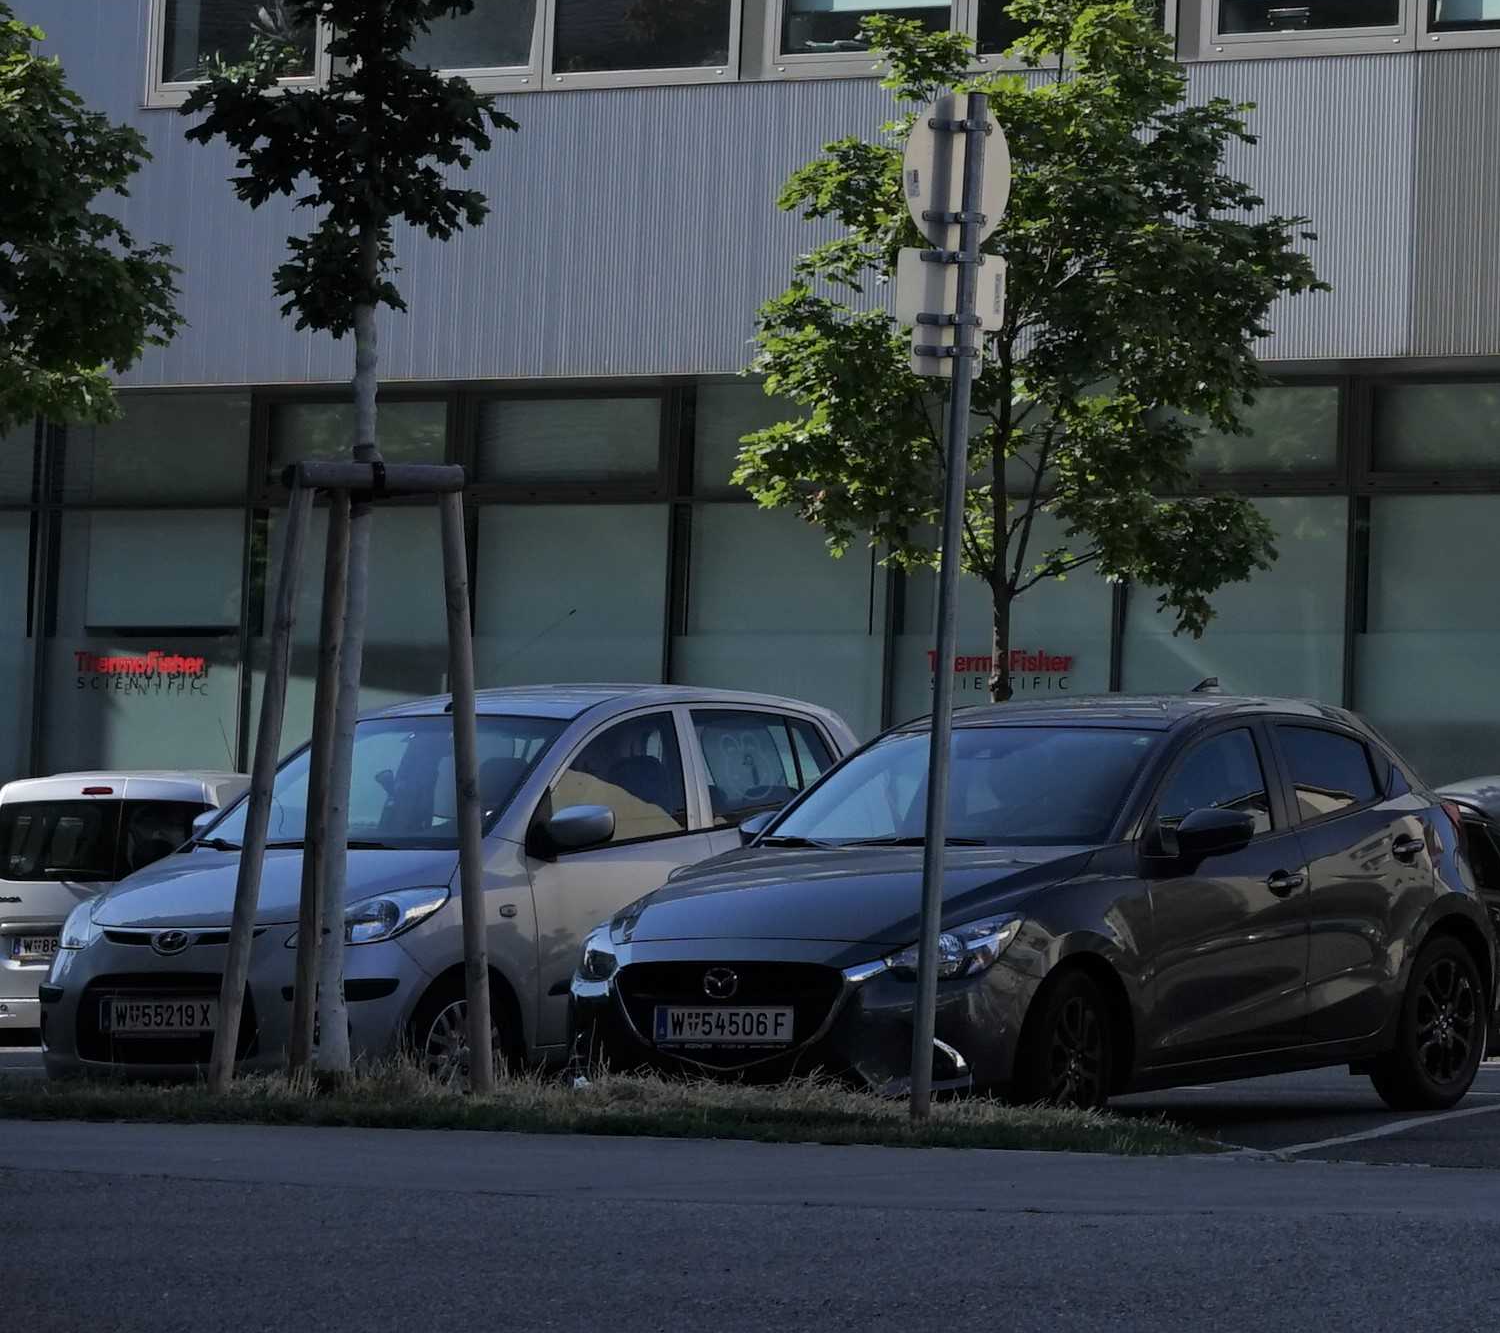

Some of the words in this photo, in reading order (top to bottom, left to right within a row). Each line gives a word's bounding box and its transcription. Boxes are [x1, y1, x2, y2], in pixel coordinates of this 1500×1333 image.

[928, 650, 1073, 673] TermFisher
[77, 676, 201, 690] SCIENTIFIC
[115, 1005, 128, 1026] W
[142, 1004, 194, 1026] 55219
[200, 1004, 210, 1026] X
[671, 1013, 685, 1036] W
[702, 1012, 768, 1036] 54506
[774, 1013, 786, 1036] F
